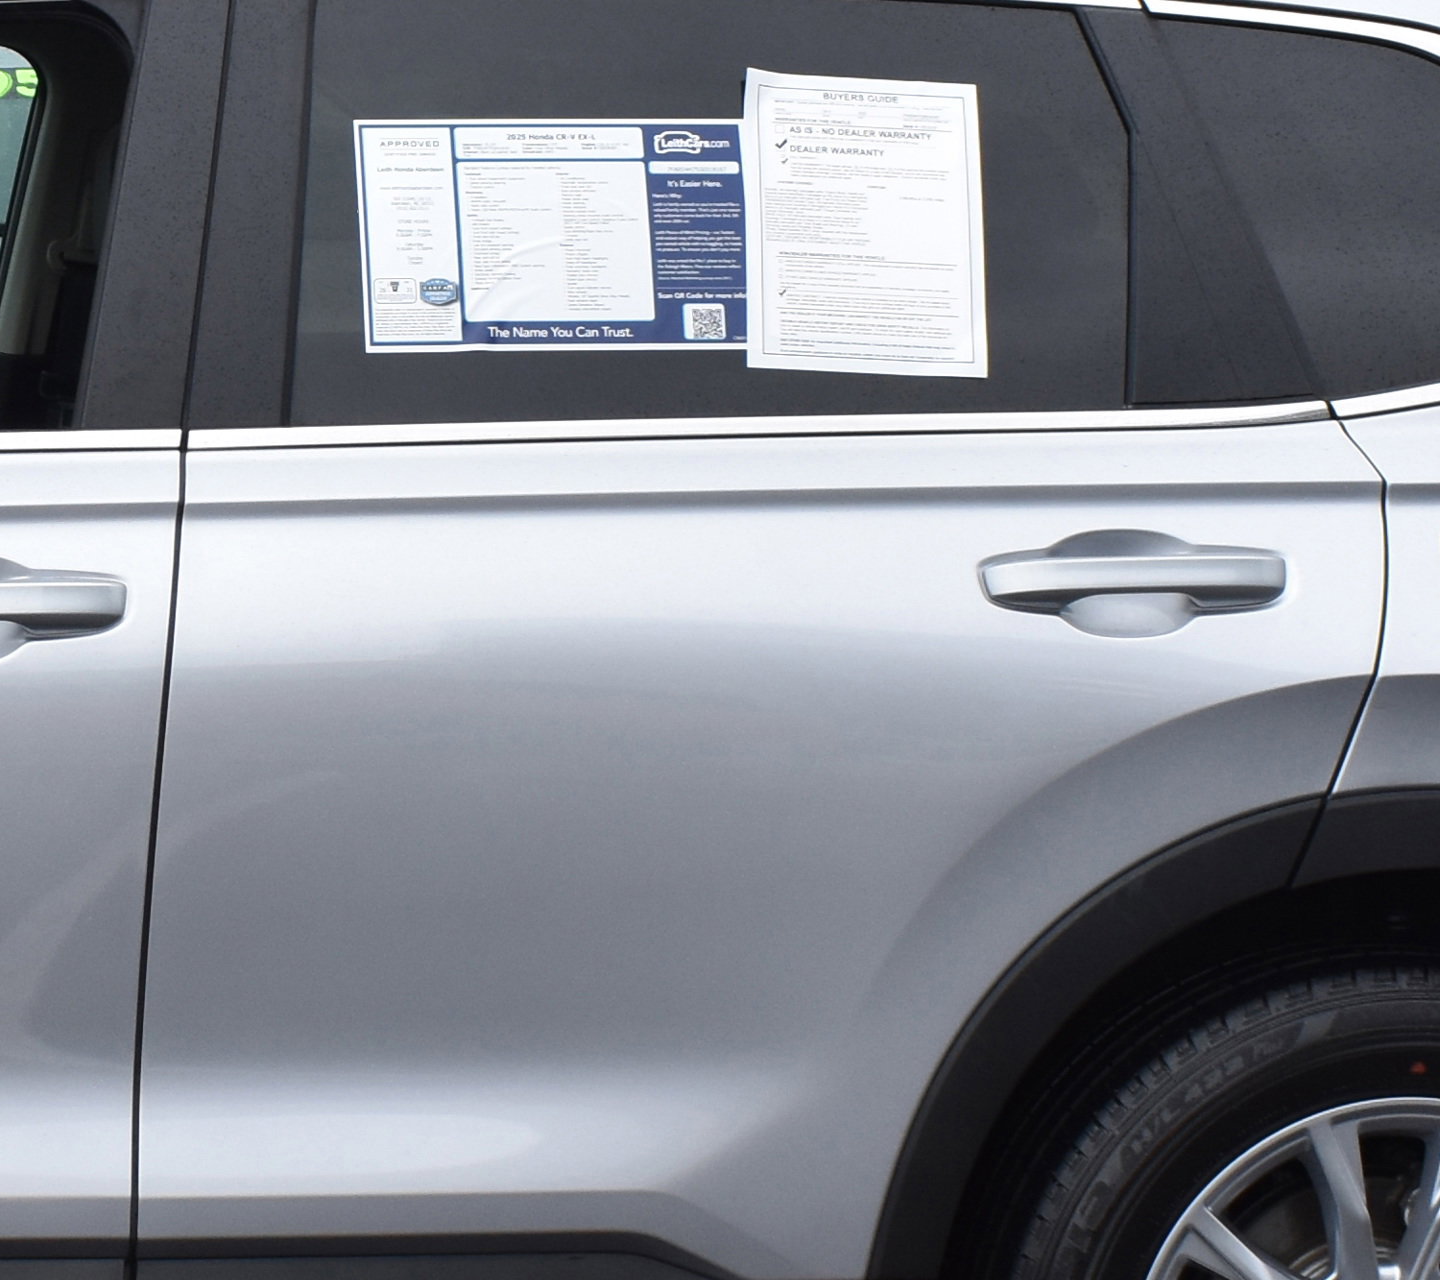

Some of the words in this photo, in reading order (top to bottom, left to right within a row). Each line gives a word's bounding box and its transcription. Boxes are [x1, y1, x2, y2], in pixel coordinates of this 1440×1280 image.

[823, 92, 864, 102] BUYERS
[867, 94, 899, 104] GUIDE
[529, 133, 554, 141] Honda
[790, 126, 802, 134] AS
[822, 128, 836, 136] NO
[838, 129, 876, 138] DEALER
[878, 131, 932, 141] WARRANTY
[379, 140, 440, 148] APPROVED
[661, 137, 730, 148] LeithCars.com
[790, 145, 828, 154] DEALER
[831, 147, 884, 157] WARRANTY
[680, 180, 701, 188] Easier
[488, 326, 510, 338] The
[513, 326, 548, 338] Name
[550, 326, 573, 338] You
[576, 326, 599, 338] Can
[601, 326, 634, 338] Trust.
